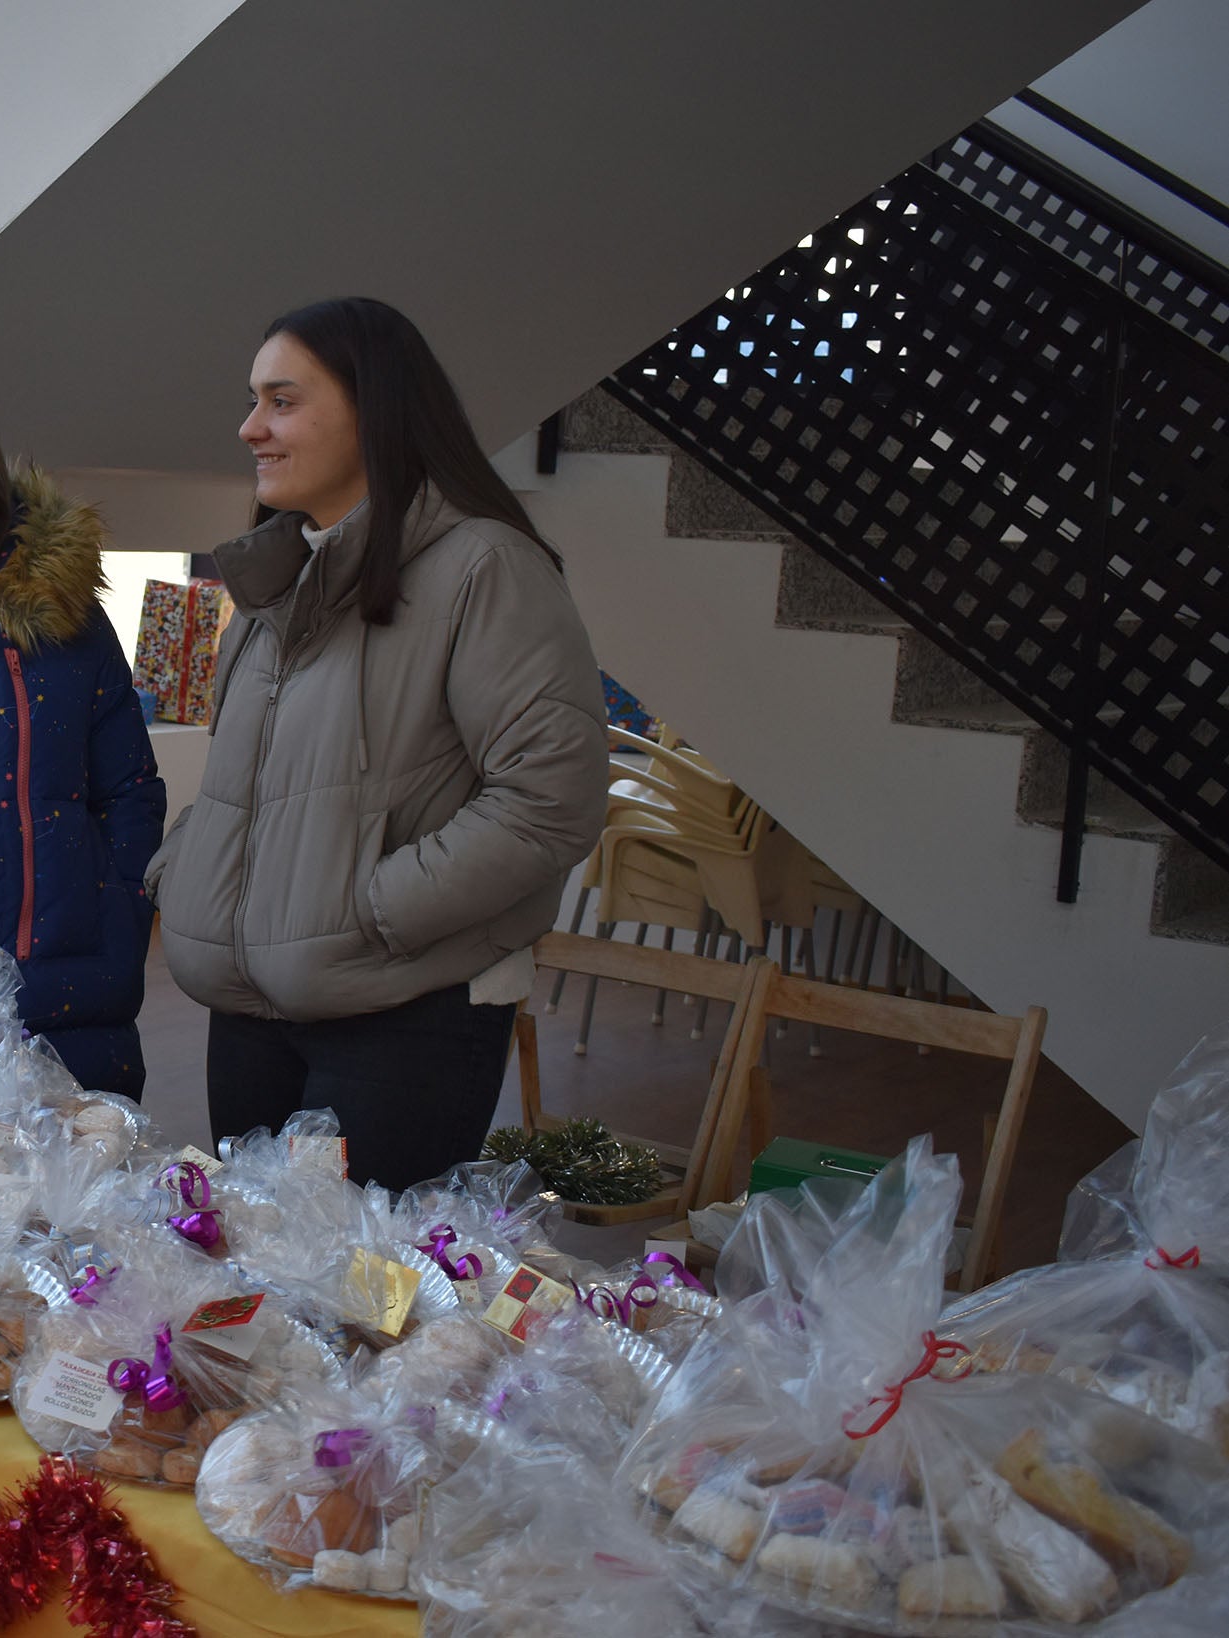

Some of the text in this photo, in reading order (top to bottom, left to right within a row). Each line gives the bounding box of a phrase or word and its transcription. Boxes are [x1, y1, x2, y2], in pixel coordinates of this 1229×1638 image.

[56, 1382, 102, 1401] MANTECADOS
[60, 1374, 107, 1393] PERRONILLAS
[44, 1396, 97, 1417] BOLLOS SUIZOS
